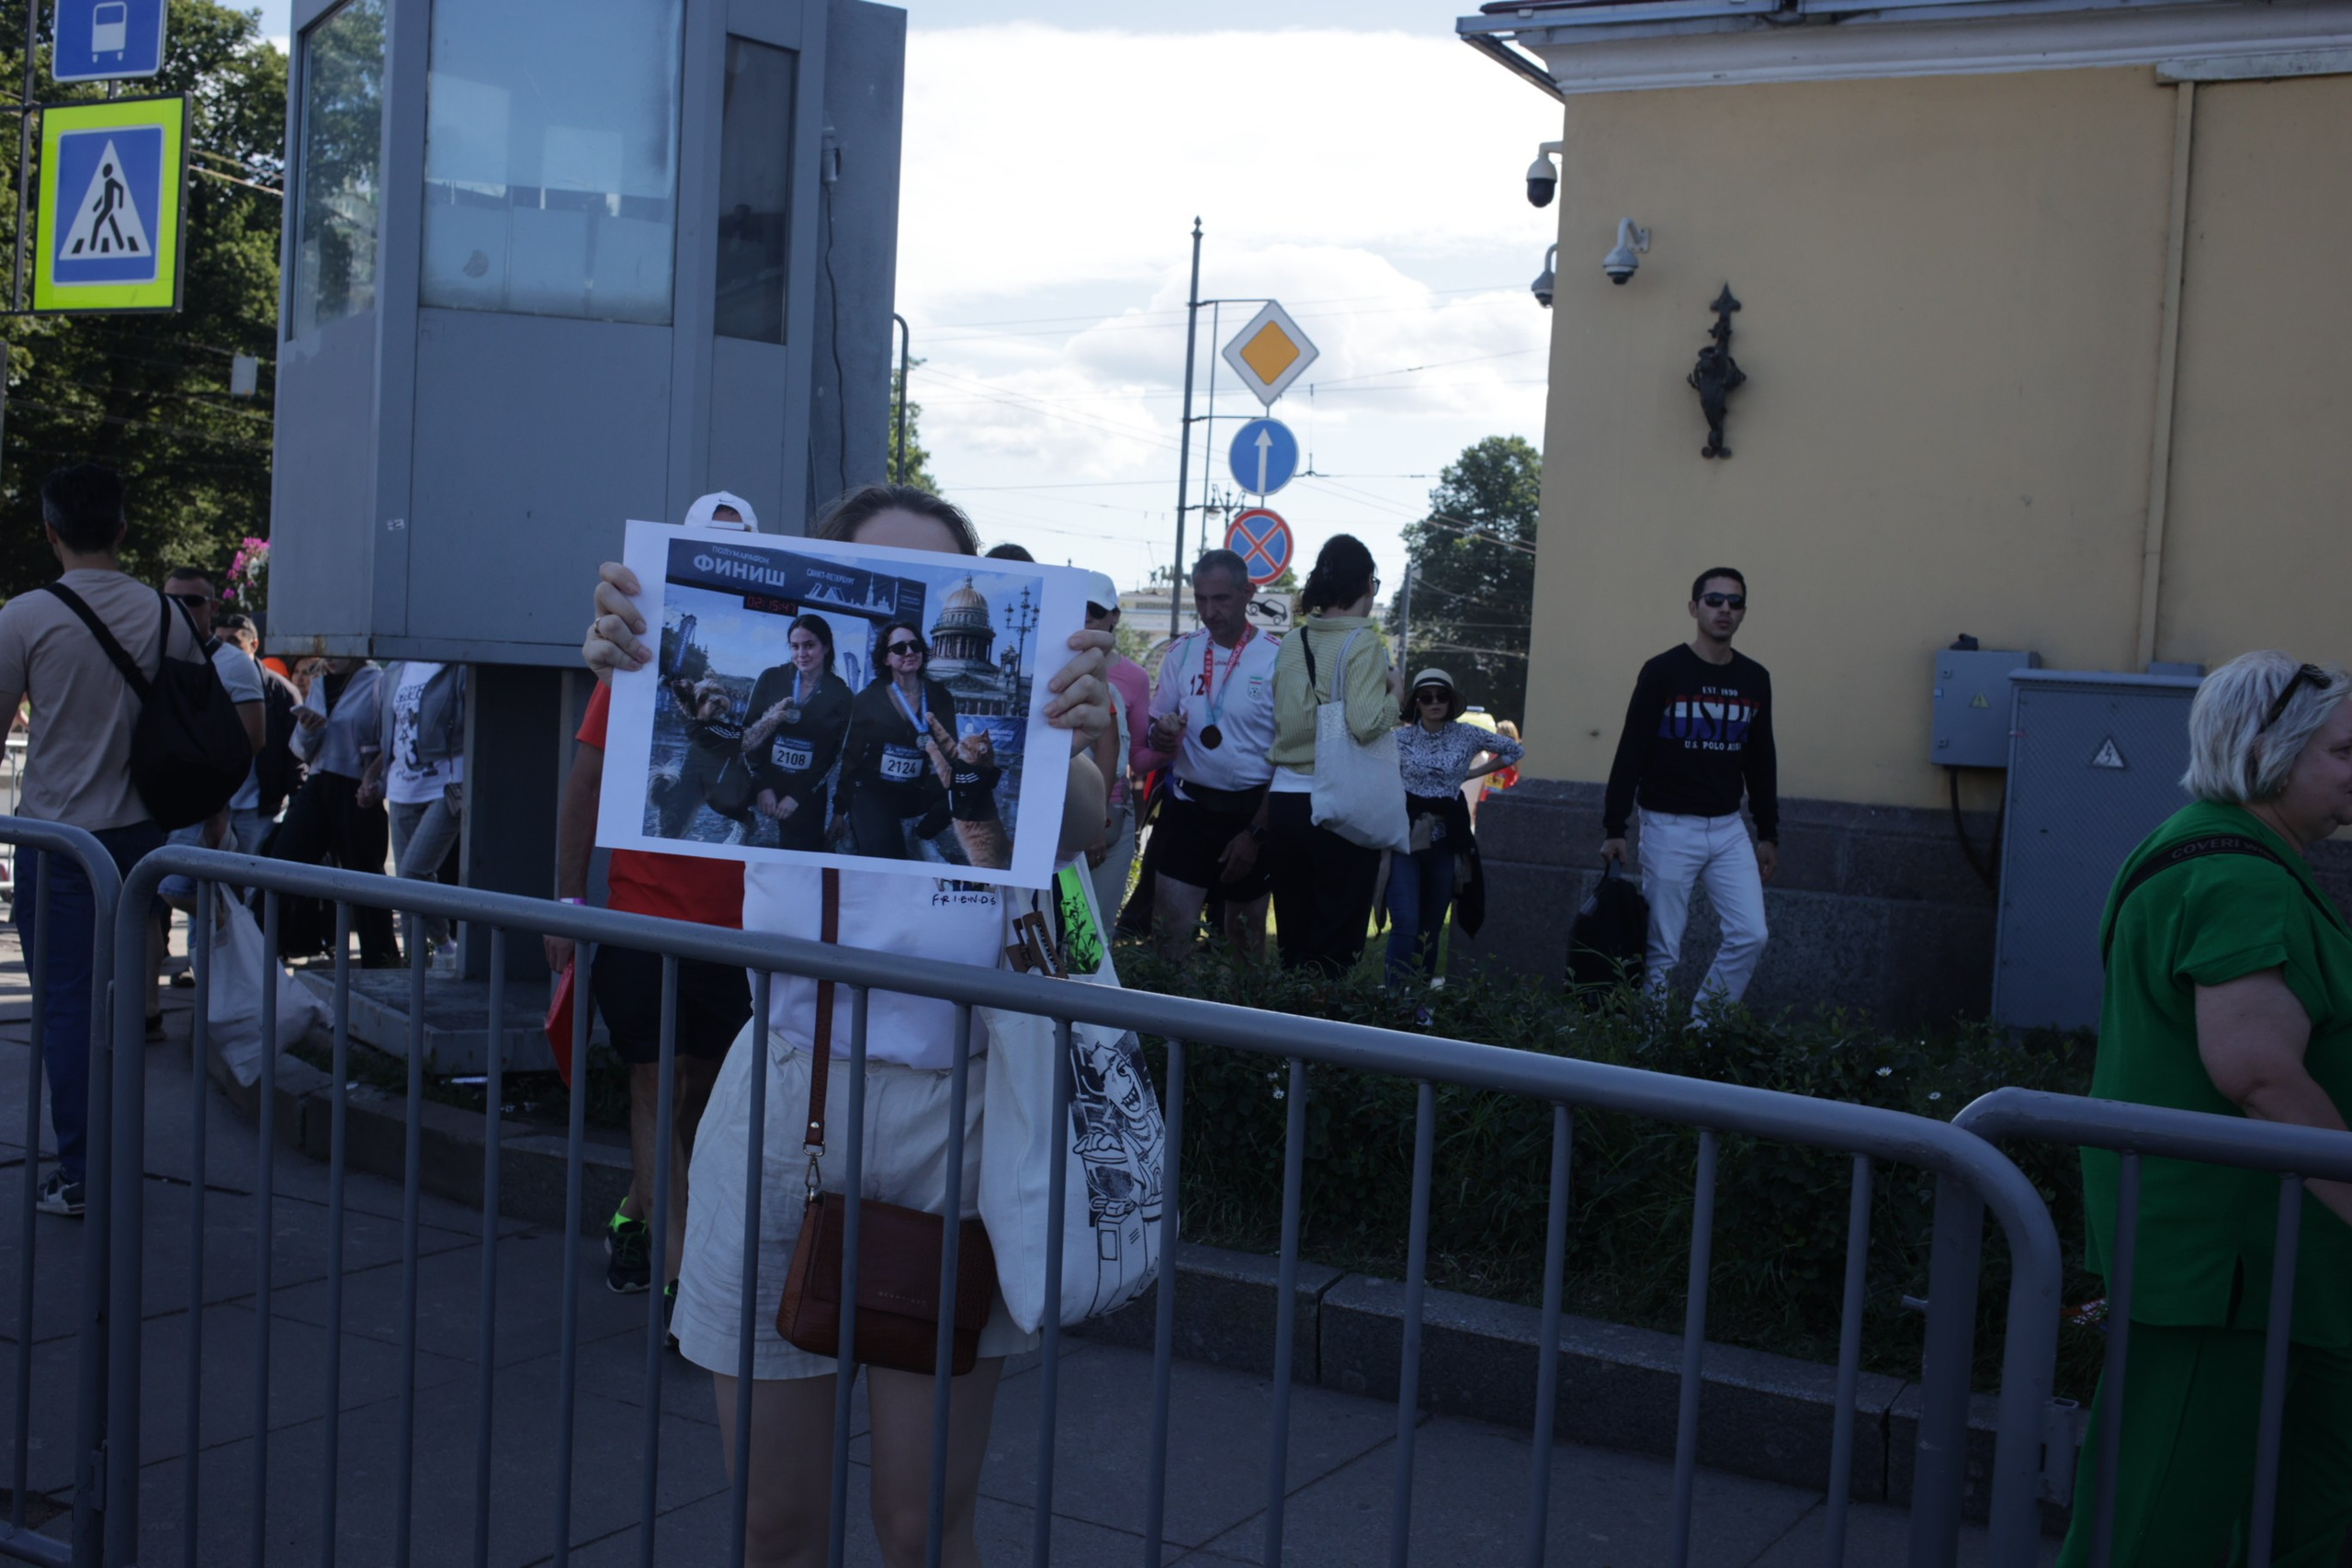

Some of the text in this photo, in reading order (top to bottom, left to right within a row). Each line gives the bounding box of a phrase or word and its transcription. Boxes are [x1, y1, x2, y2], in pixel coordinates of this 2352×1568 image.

[712, 545, 770, 565] ПОЛУМАРАФОН
[693, 553, 786, 587] ФИНИШ
[807, 568, 855, 585] САНКТ-ПЕТЕРБУРГ
[746, 595, 797, 615] 02:15:47
[1191, 674, 1205, 696] 12
[1702, 740, 1724, 751] POLO
[776, 750, 806, 766] 2108
[888, 758, 917, 774] 2124
[2171, 838, 2240, 860] COVERI
